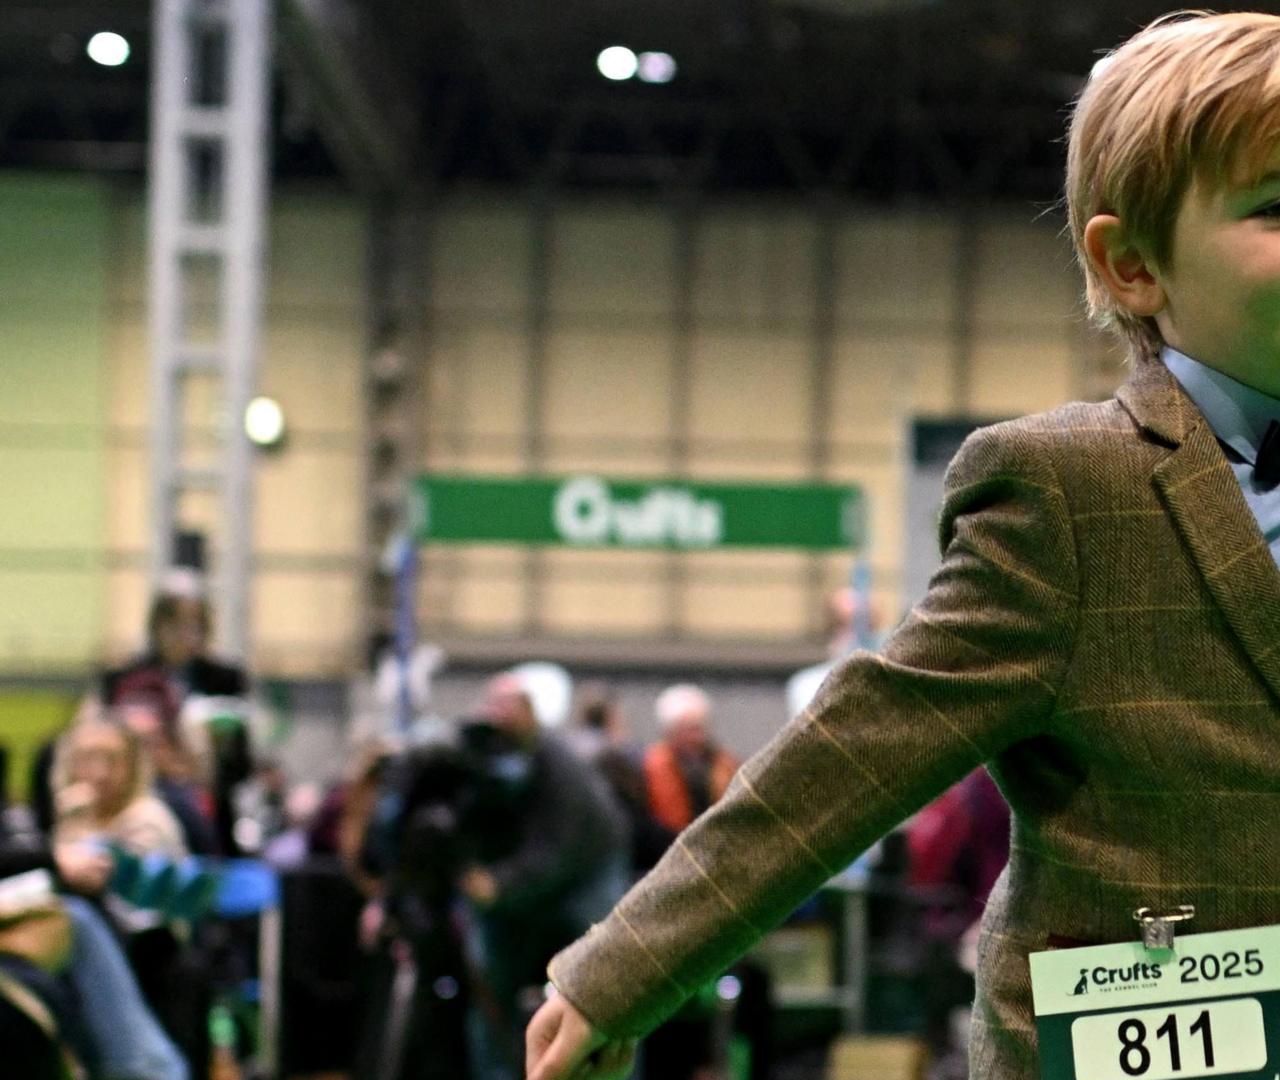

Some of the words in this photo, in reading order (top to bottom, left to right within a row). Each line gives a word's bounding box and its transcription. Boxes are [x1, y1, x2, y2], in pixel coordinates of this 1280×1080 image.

[1092, 962, 1162, 985] Crufts
[1179, 948, 1264, 984] 2025
[1117, 1010, 1215, 1077] 811
